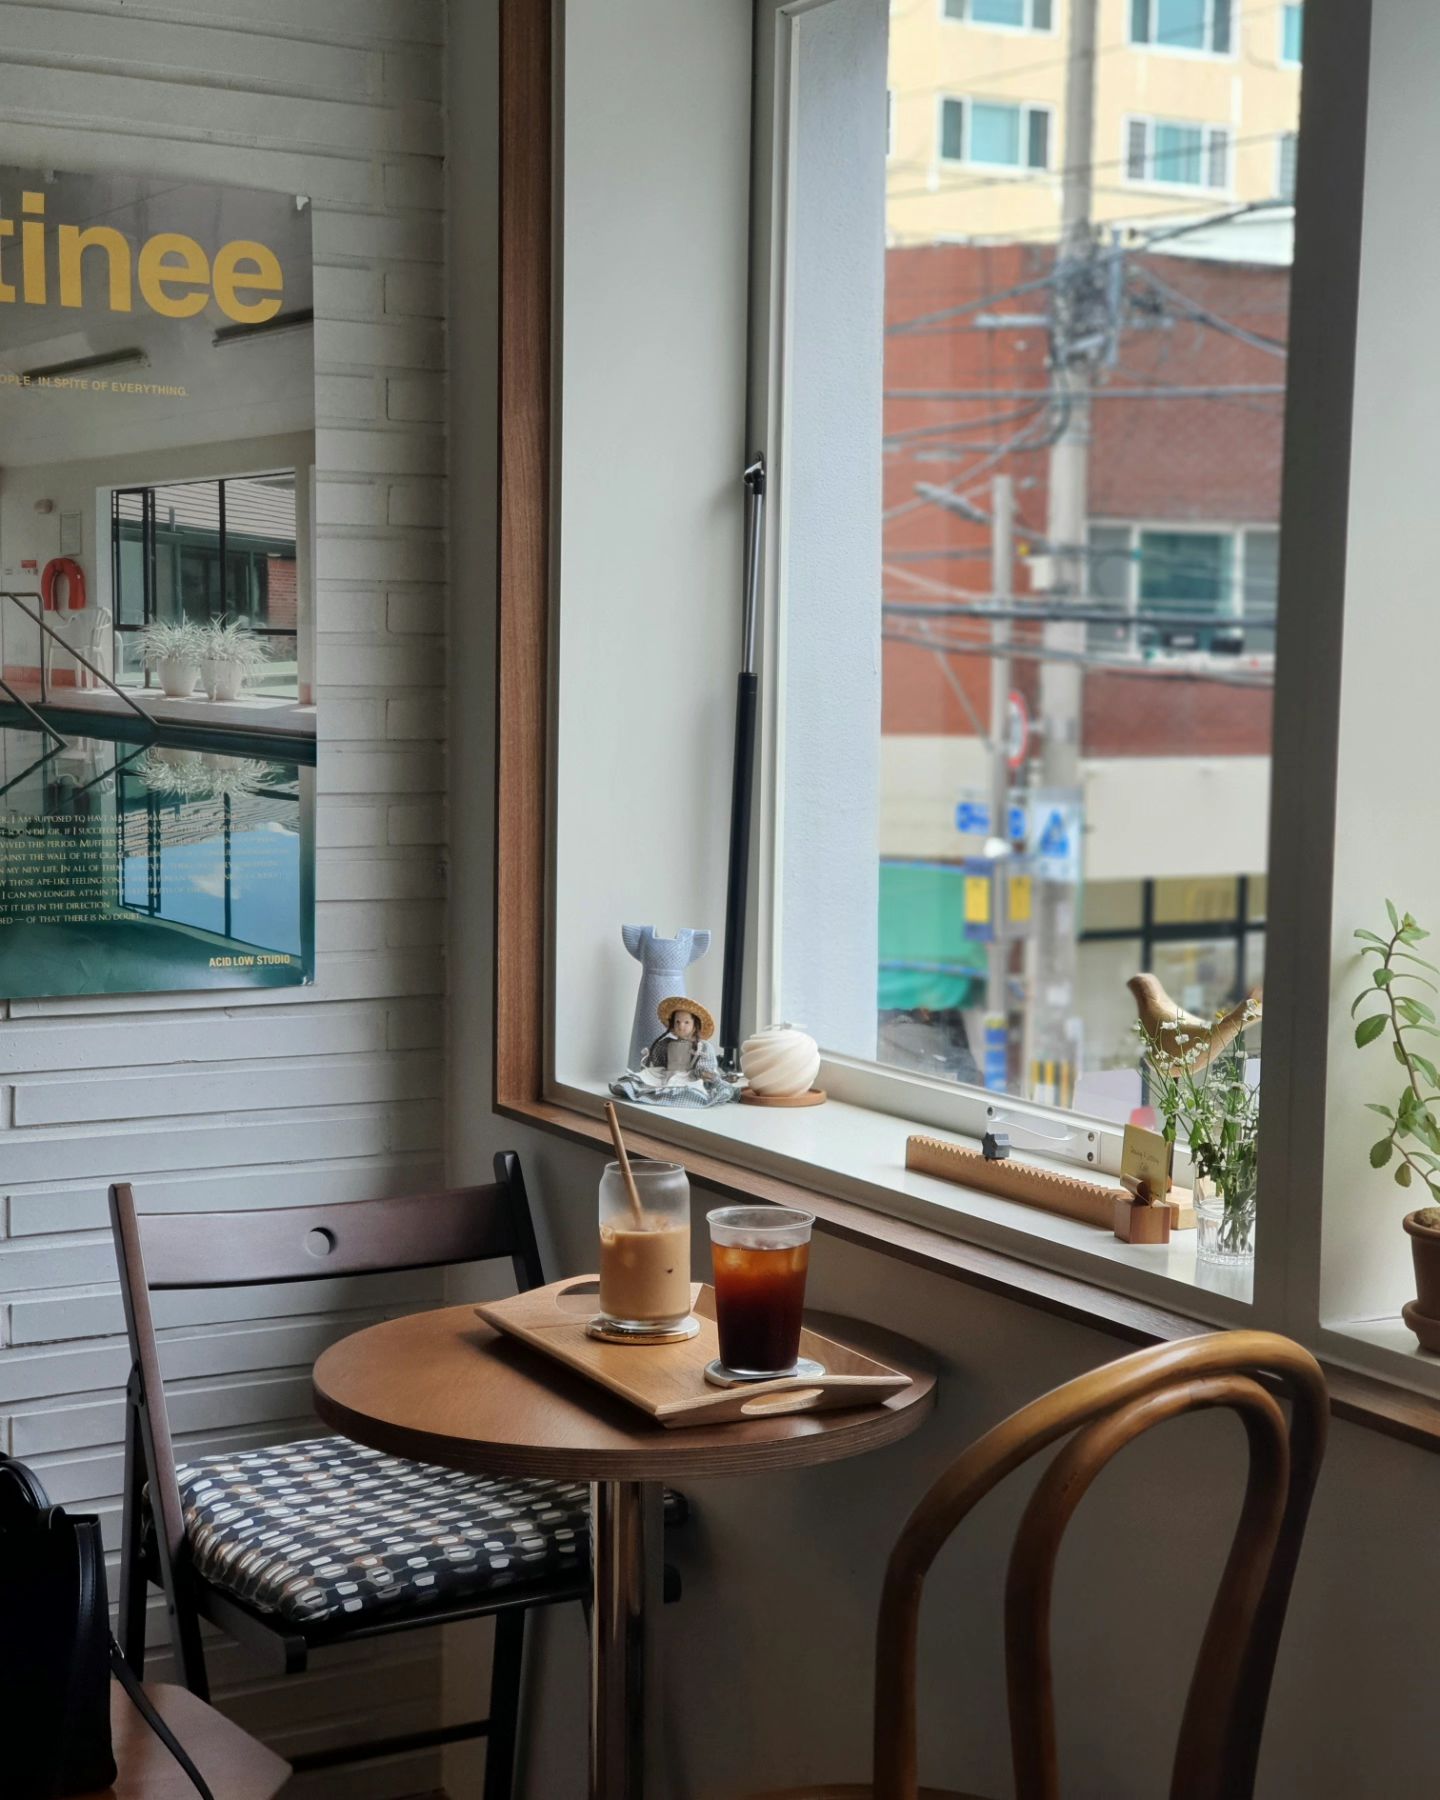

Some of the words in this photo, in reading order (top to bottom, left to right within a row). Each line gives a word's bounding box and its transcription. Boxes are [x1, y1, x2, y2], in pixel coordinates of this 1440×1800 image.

[38, 376, 50, 387] IN
[54, 377, 88, 390] SPITE
[92, 380, 108, 391] OF
[112, 382, 189, 397] EVERYTHING.
[18, 815, 31, 823] AM
[34, 815, 71, 823] SUPPOSED
[74, 815, 86, 823] TO
[80, 839, 116, 848] MUFFLED
[29, 853, 45, 861] THE
[69, 852, 81, 860] OF
[83, 852, 98, 860] THE
[7, 866, 19, 874] MY
[22, 866, 40, 874] NEW
[73, 865, 87, 873] ALL
[88, 864, 98, 872] OF
[9, 878, 34, 887] THOSE
[37, 877, 69, 886] APE-LIKE
[72, 876, 106, 885] FEELINGS
[7, 891, 27, 899] CAN
[28, 890, 42, 898] NO
[44, 889, 76, 898] LONGER
[78, 888, 108, 897] ATTAIN
[37, 903, 47, 911] IN
[66, 902, 110, 910] DIRECTION
[26, 915, 36, 924] OF
[39, 915, 60, 923] THAT
[64, 914, 89, 923] THERE
[90, 913, 97, 922] IS
[98, 913, 112, 922] NO
[209, 956, 232, 967] ACID
[233, 956, 254, 967] LOW
[256, 954, 290, 965] STUDIO
